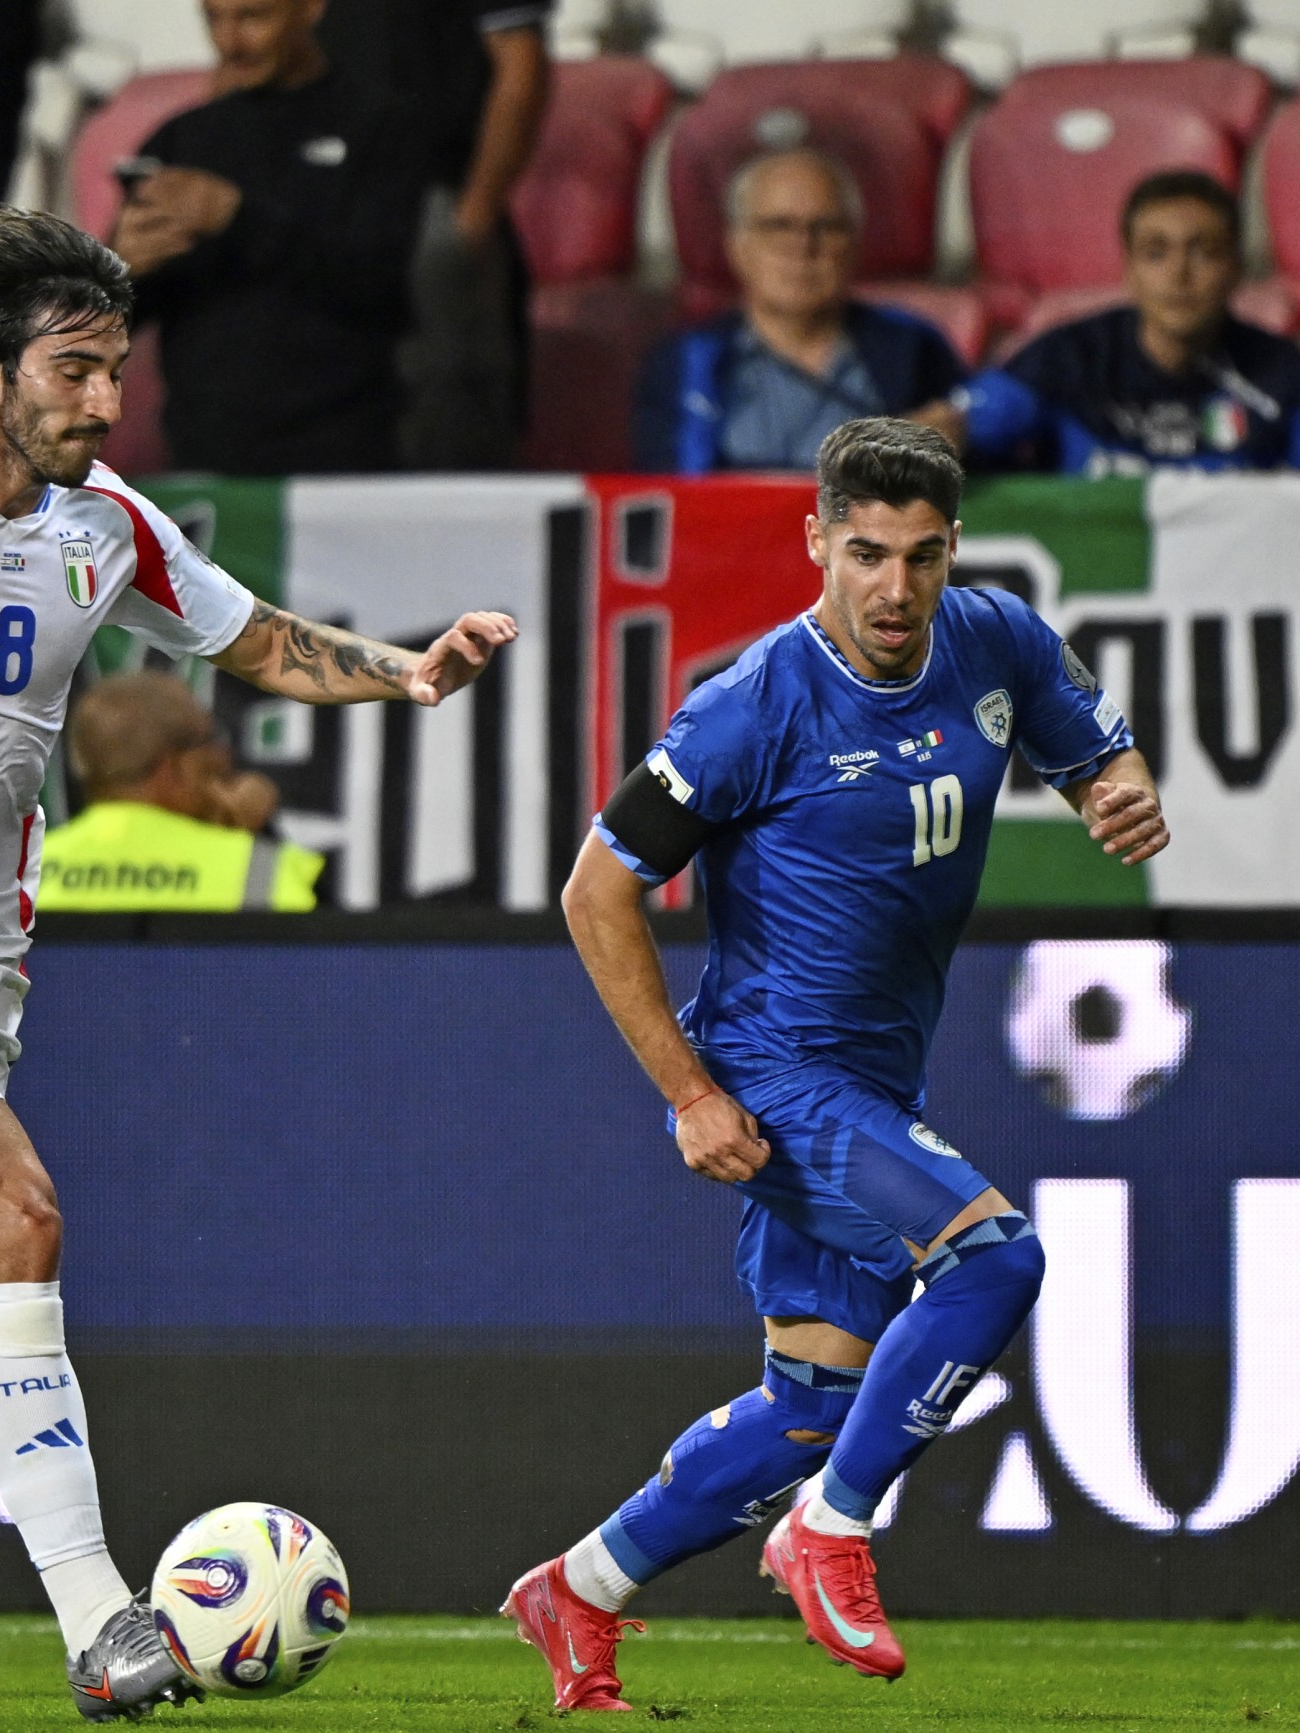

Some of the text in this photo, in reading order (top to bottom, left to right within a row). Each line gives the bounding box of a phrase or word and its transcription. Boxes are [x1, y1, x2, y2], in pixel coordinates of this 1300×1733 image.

[64, 546, 92, 558] ITALIA
[980, 696, 1004, 713] ISRAEL
[829, 750, 879, 767] Reebok
[909, 774, 963, 867] 10
